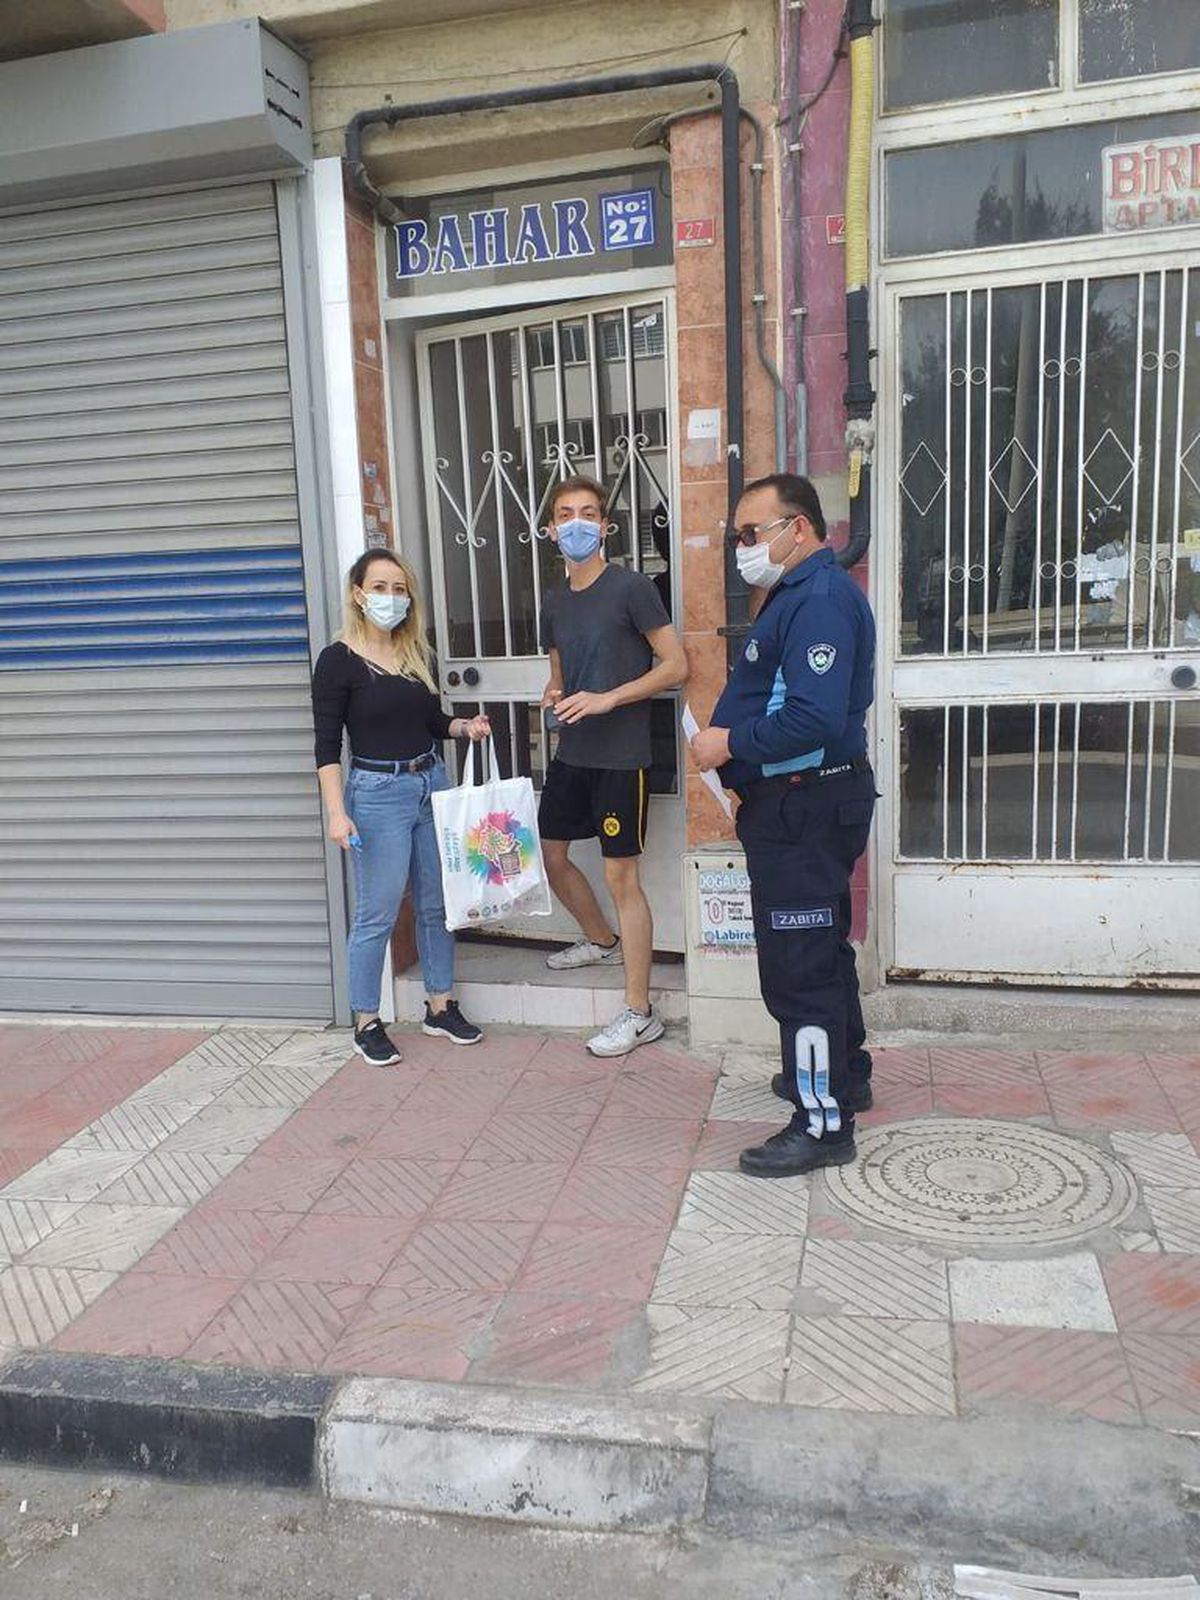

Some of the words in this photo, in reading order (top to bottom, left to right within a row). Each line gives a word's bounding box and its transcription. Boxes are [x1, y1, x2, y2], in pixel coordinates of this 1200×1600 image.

[606, 200, 647, 217] No:
[393, 197, 596, 280] BAHAR
[608, 215, 648, 245] 27
[685, 222, 704, 239] 27
[779, 913, 825, 926] ZABITA
[715, 929, 757, 942] Labire
